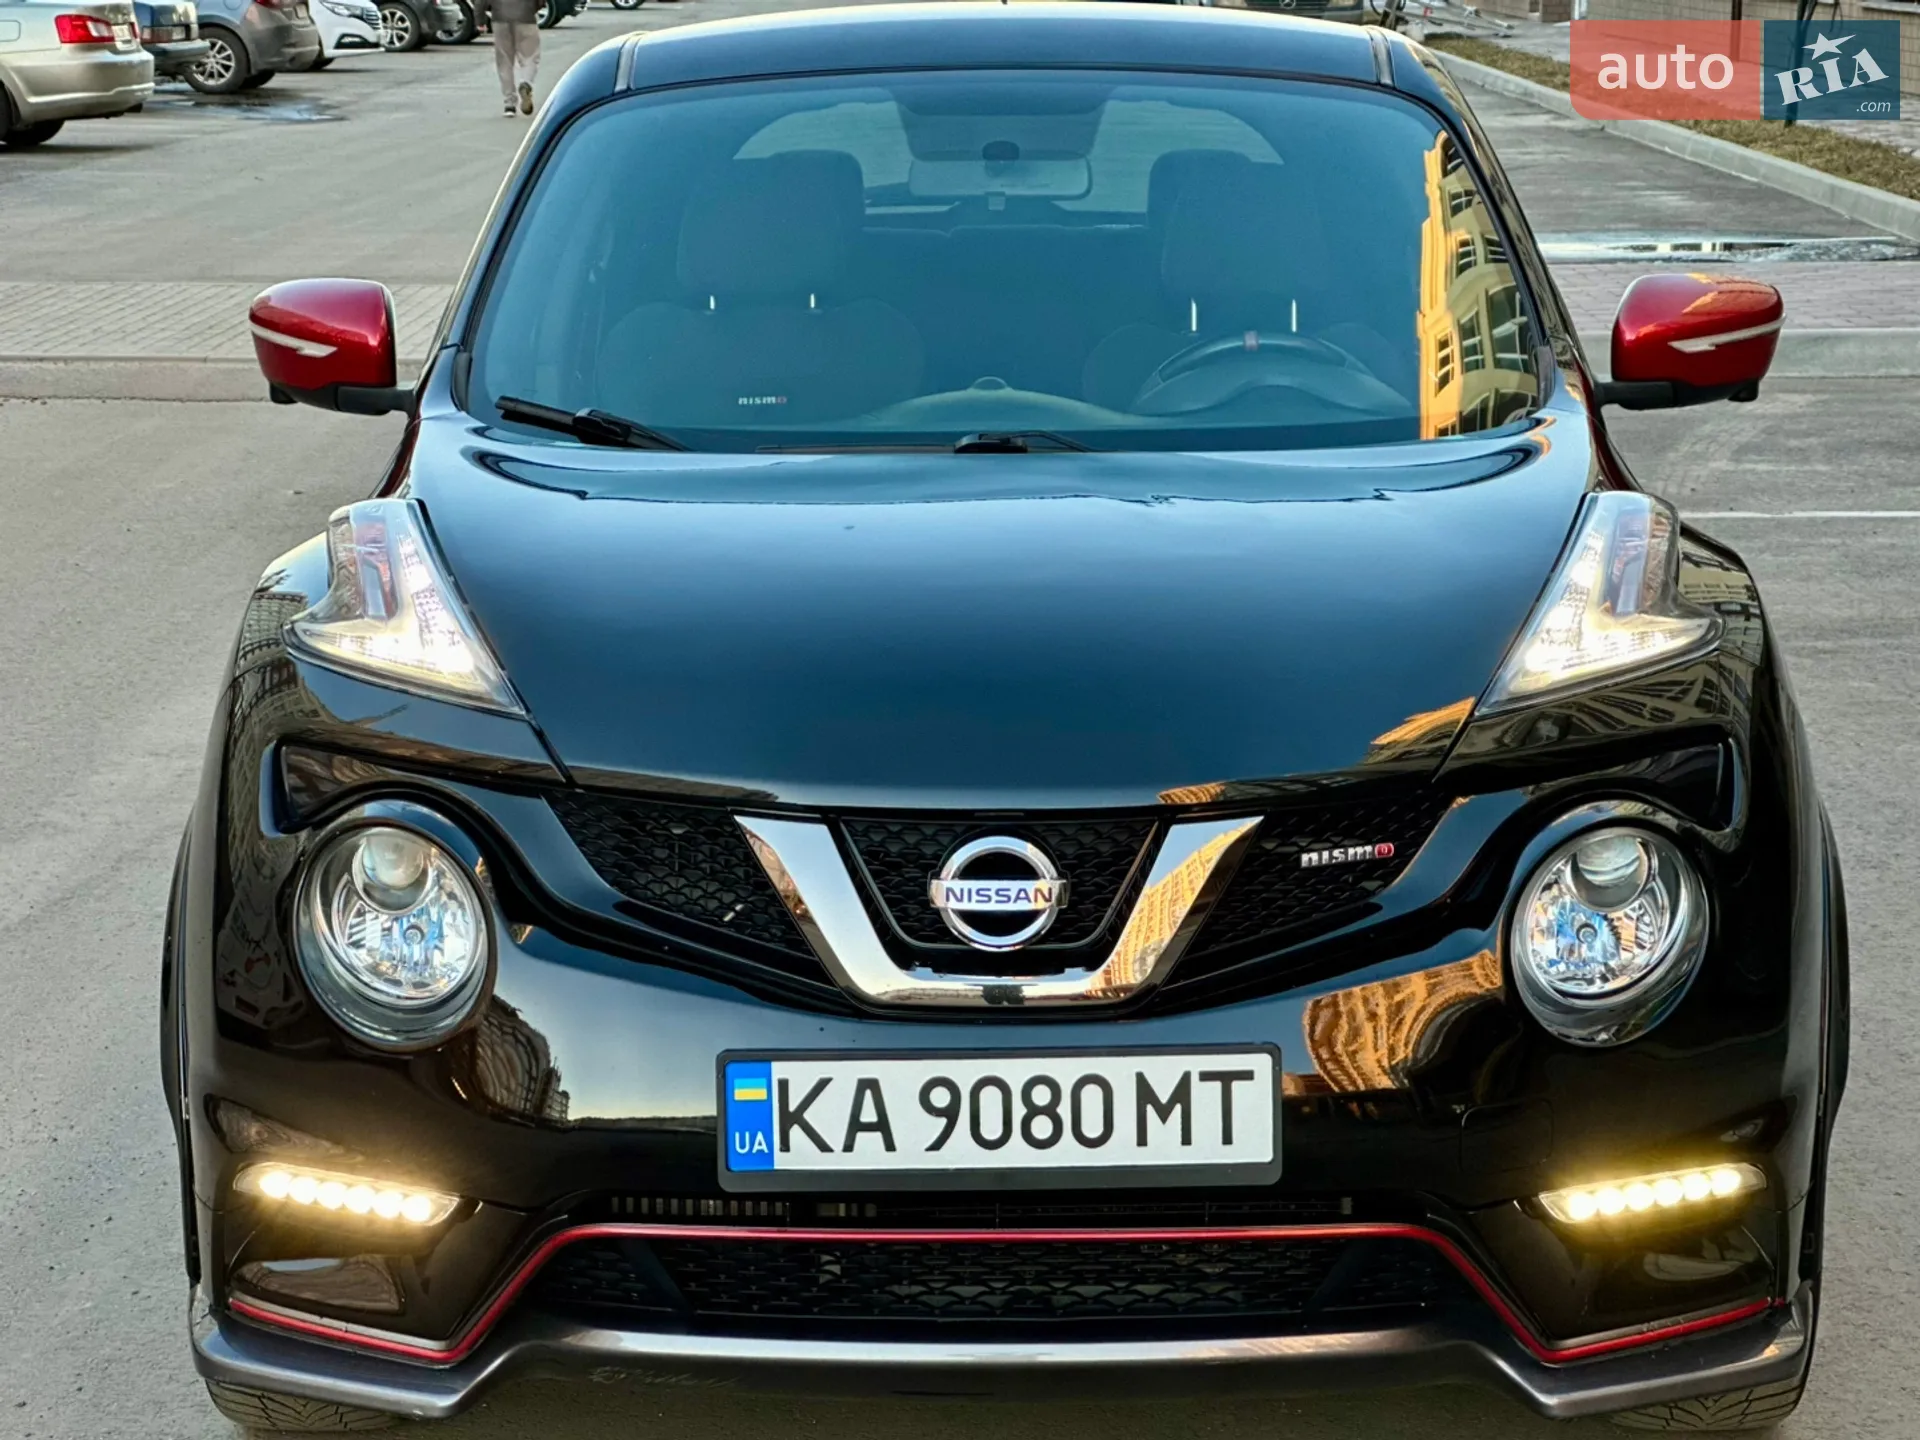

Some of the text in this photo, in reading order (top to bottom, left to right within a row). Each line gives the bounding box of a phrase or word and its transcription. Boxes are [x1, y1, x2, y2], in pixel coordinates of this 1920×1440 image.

[945, 886, 1053, 904] NISSAN
[777, 1069, 1255, 1153] KA 9080 MT
[734, 1131, 769, 1154] UA
